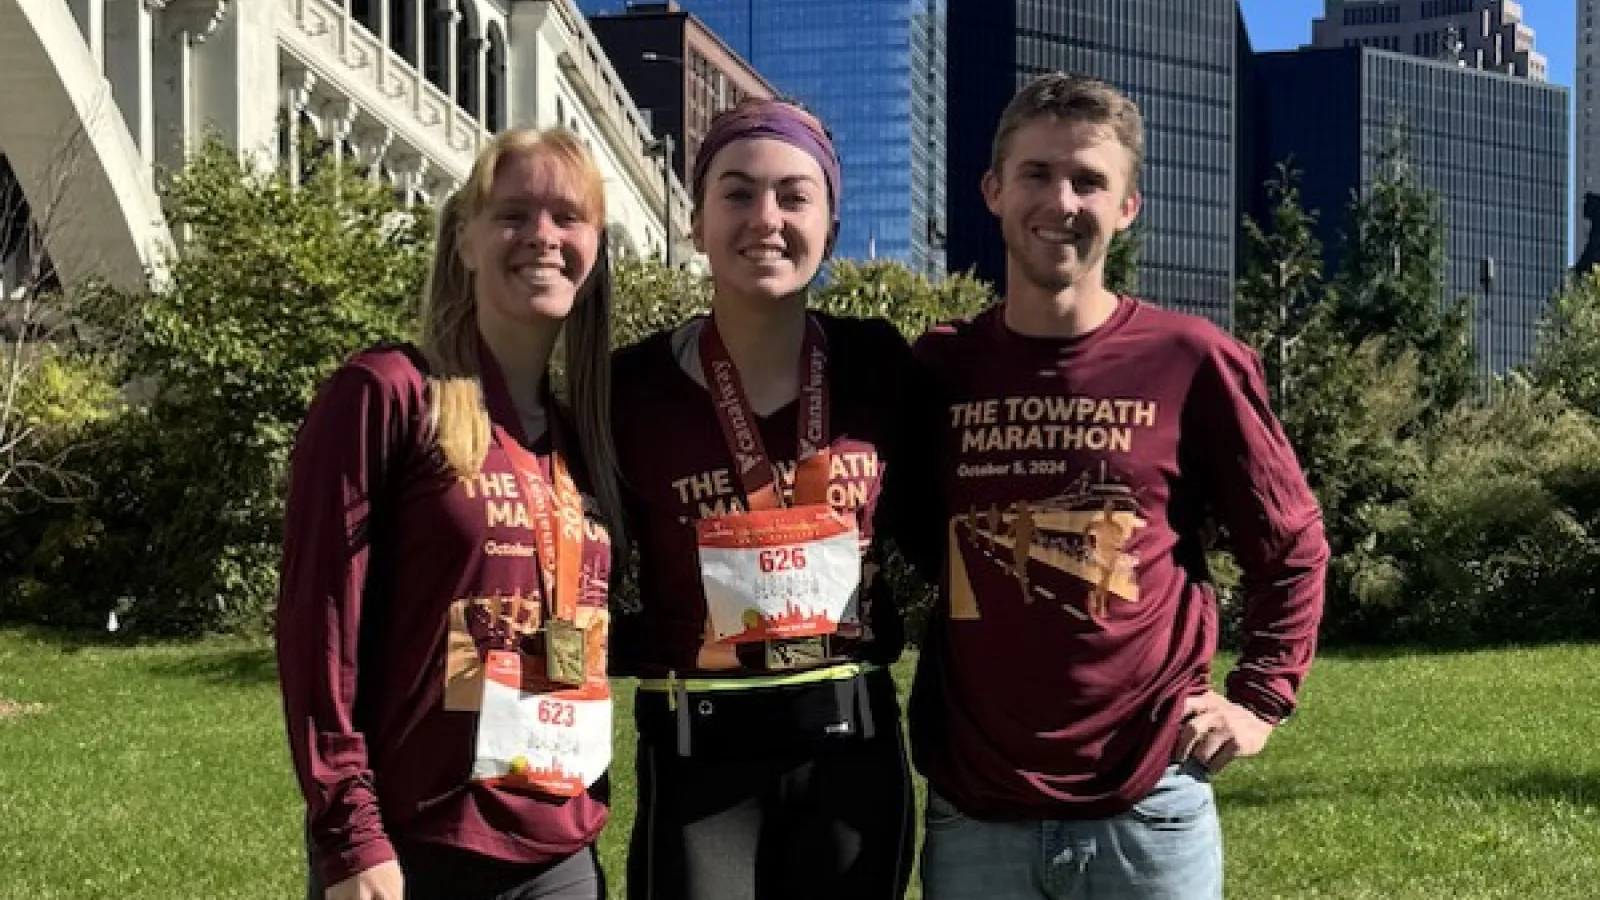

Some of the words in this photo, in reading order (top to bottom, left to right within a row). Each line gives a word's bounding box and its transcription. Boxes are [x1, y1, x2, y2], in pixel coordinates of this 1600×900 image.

[950, 400, 998, 428] THE
[1004, 396, 1157, 427] TOWPATH
[962, 425, 1132, 453] MARATHON
[957, 462, 1010, 477] October
[458, 473, 518, 498] THE
[671, 468, 733, 503] THE
[759, 547, 807, 573] 626
[537, 699, 577, 728] 623
